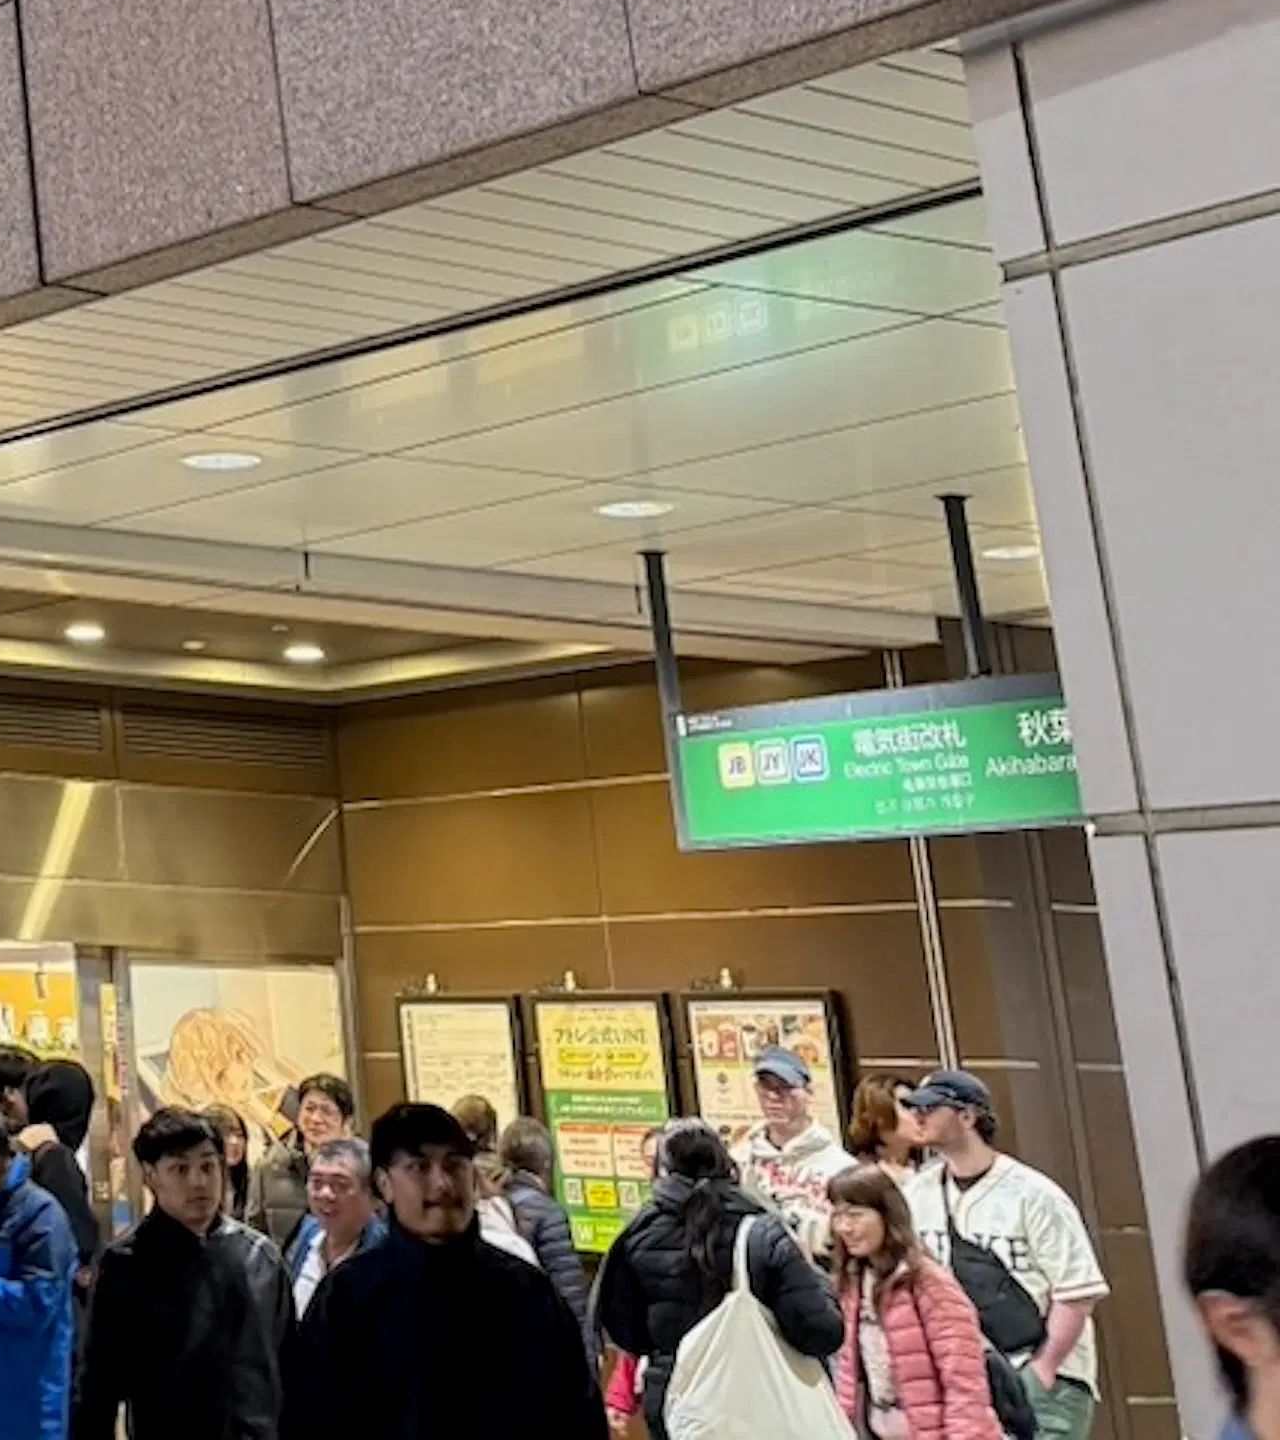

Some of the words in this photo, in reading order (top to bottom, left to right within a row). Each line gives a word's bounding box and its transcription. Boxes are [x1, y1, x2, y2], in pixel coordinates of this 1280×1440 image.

[844, 759, 893, 779] Electric
[894, 757, 933, 774] Town
[934, 752, 970, 770] Gate
